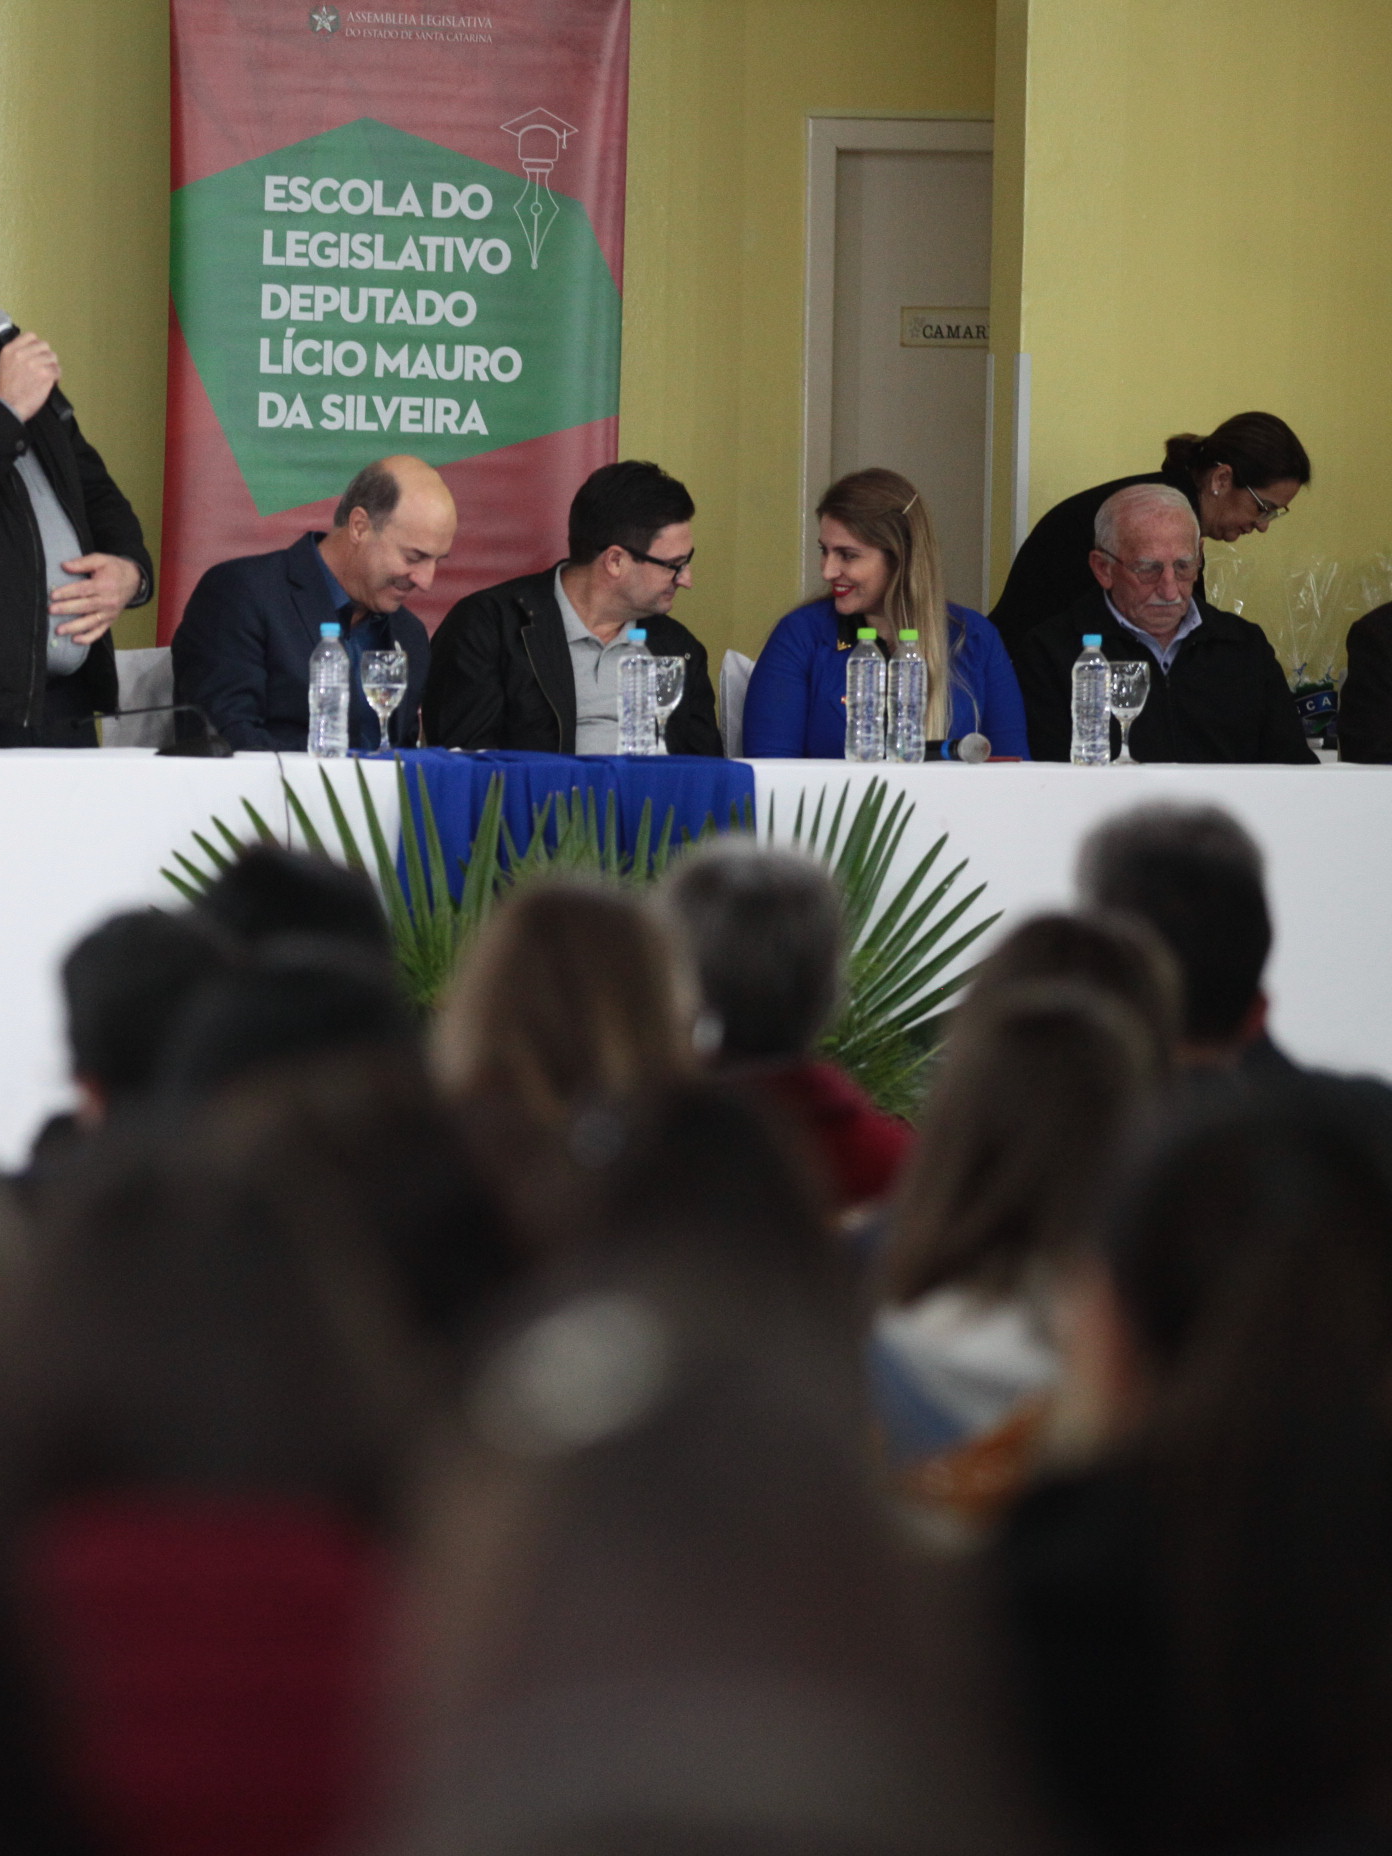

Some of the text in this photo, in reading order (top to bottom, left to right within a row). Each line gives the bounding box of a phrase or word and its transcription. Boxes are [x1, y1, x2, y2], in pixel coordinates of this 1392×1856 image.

[345, 27, 493, 44] DO ESTADO DE SANTA CATARINA
[346, 11, 493, 28] ASSEMBLEIA LEGISLATIVA
[264, 174, 494, 221] ESCOLA DO
[262, 228, 513, 276] LEGISLATIVO
[261, 282, 478, 328] DEPUTADO
[922, 324, 990, 340] CAMAR
[259, 327, 523, 383] LÍCIO MAURO
[258, 391, 490, 436] DA SILVEIRA
